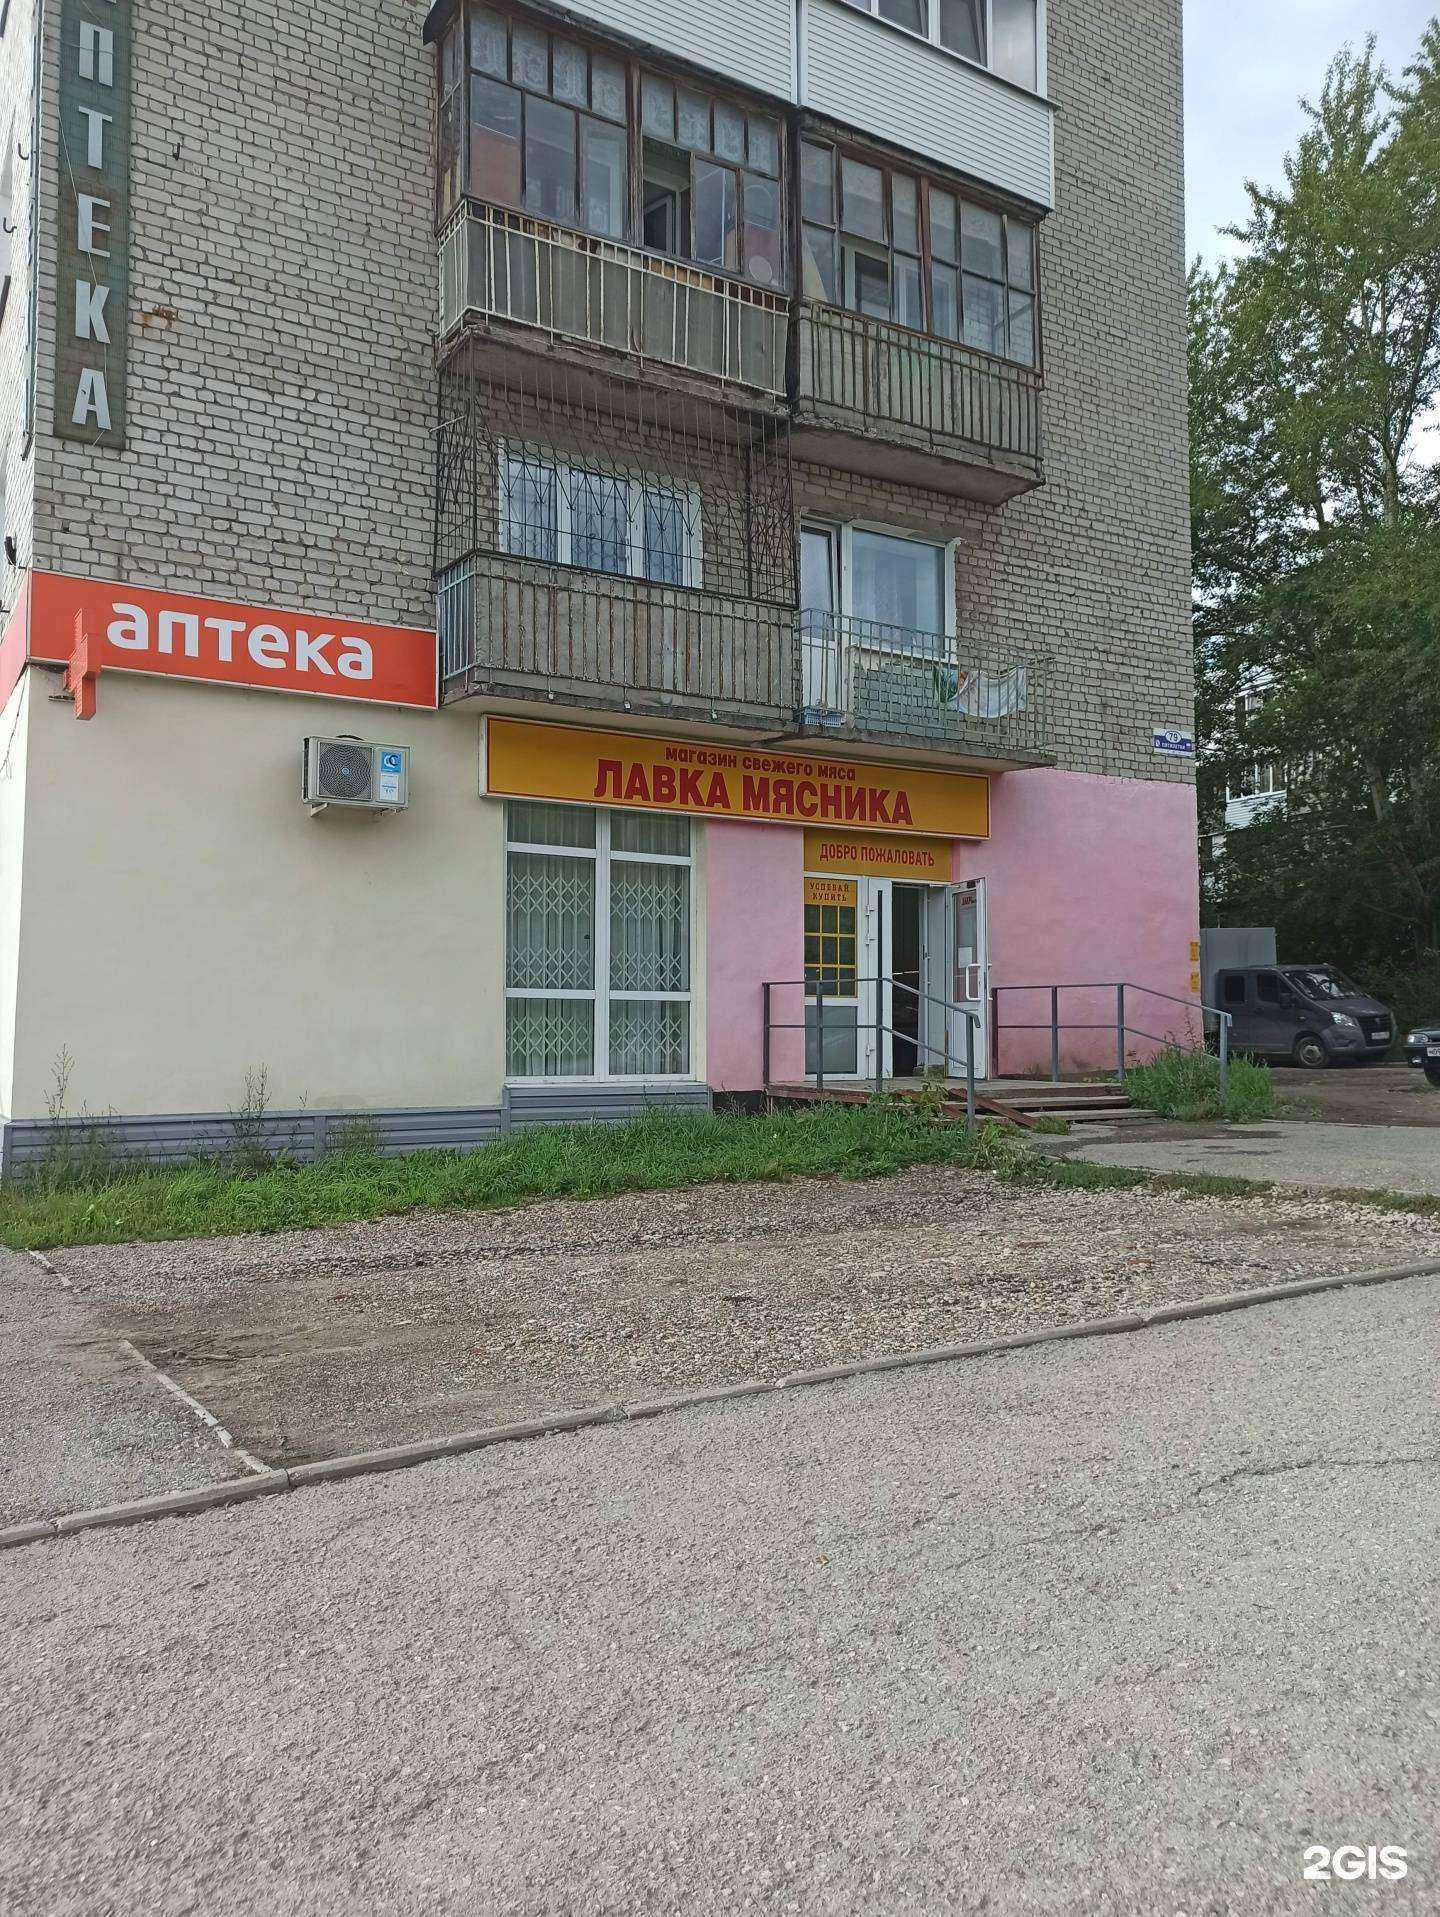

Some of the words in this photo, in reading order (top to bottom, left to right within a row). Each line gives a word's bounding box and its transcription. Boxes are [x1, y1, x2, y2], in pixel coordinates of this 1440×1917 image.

[72, 0, 117, 430] ПТЕКА
[106, 602, 374, 680] аптека
[665, 747, 737, 768] магазин
[742, 757, 813, 777] свежего
[817, 764, 856, 781] мяса
[593, 758, 732, 809] ЛАВКА
[742, 774, 914, 826] МЯСНИКА
[820, 843, 858, 862] ДОБРО
[861, 846, 935, 867] ПОЖАЛОВАТЬ
[810, 882, 849, 892] УСПЕВАЙ
[812, 892, 847, 902] КУПИТЬ
